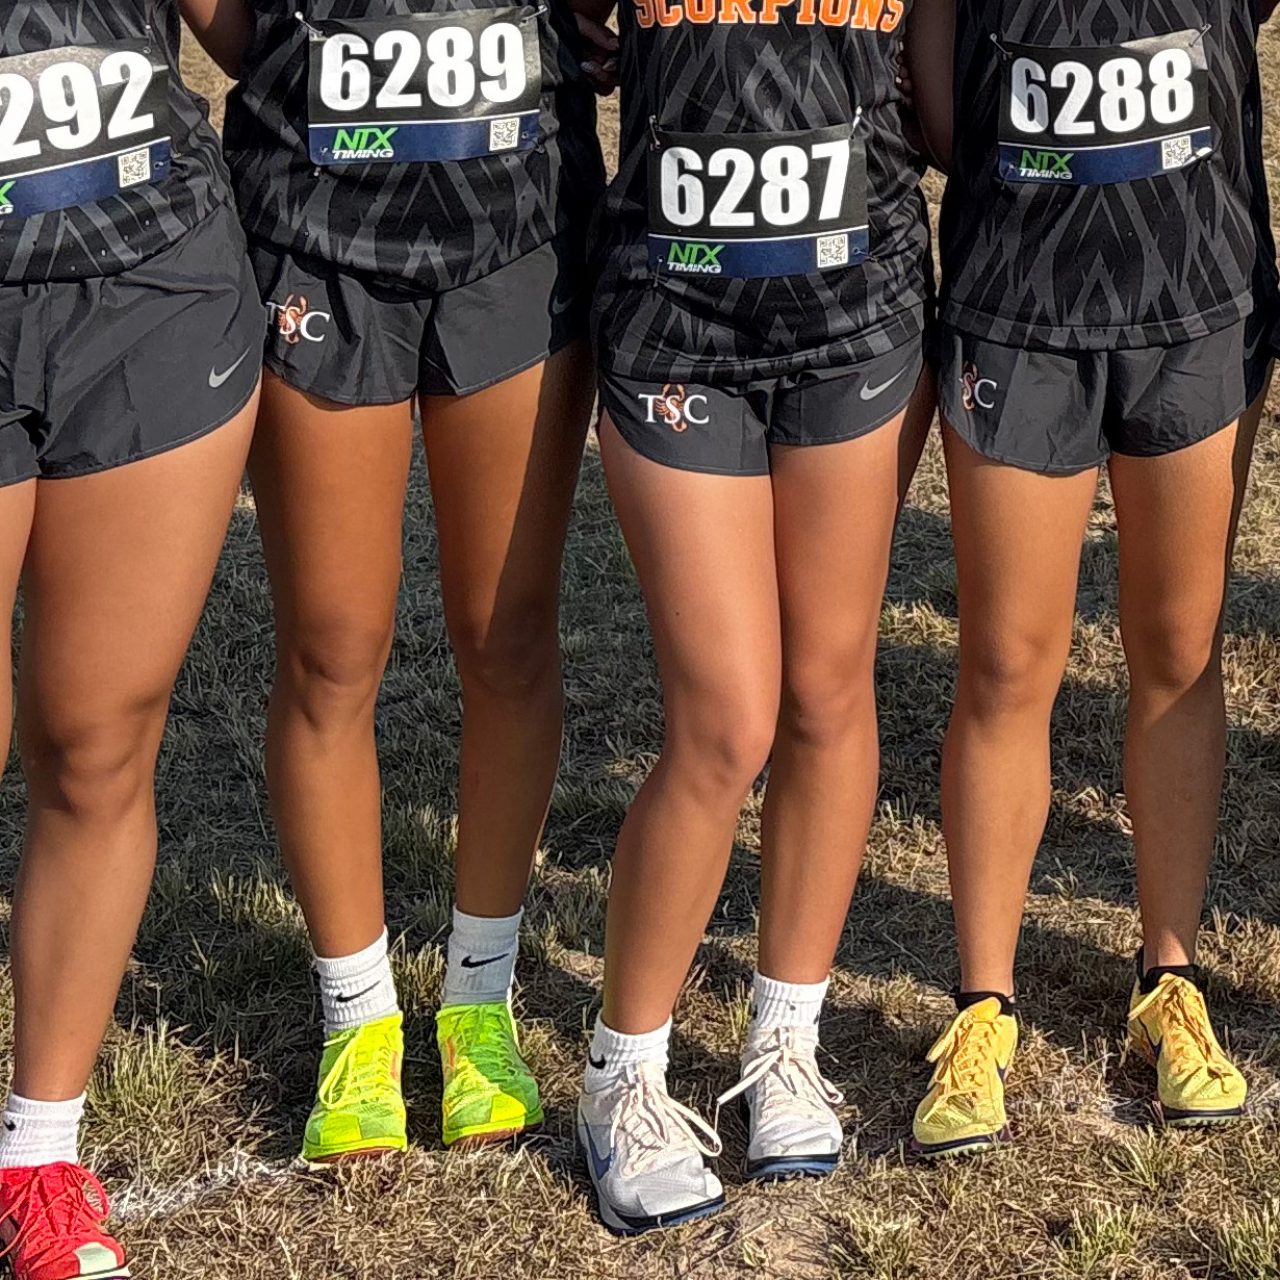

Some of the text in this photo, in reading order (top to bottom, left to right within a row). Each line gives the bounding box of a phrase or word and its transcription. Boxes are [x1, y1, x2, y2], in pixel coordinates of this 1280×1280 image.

[320, 22, 527, 111] 6289
[1010, 48, 1194, 135] 6288
[332, 127, 399, 150] NTX
[332, 148, 394, 159] TIMING
[1020, 150, 1074, 171] NTX
[661, 139, 850, 227] 6287
[1019, 167, 1073, 180] TIMING
[668, 242, 726, 264] NTX
[667, 262, 722, 273] TIMING
[638, 393, 710, 425] TSC
